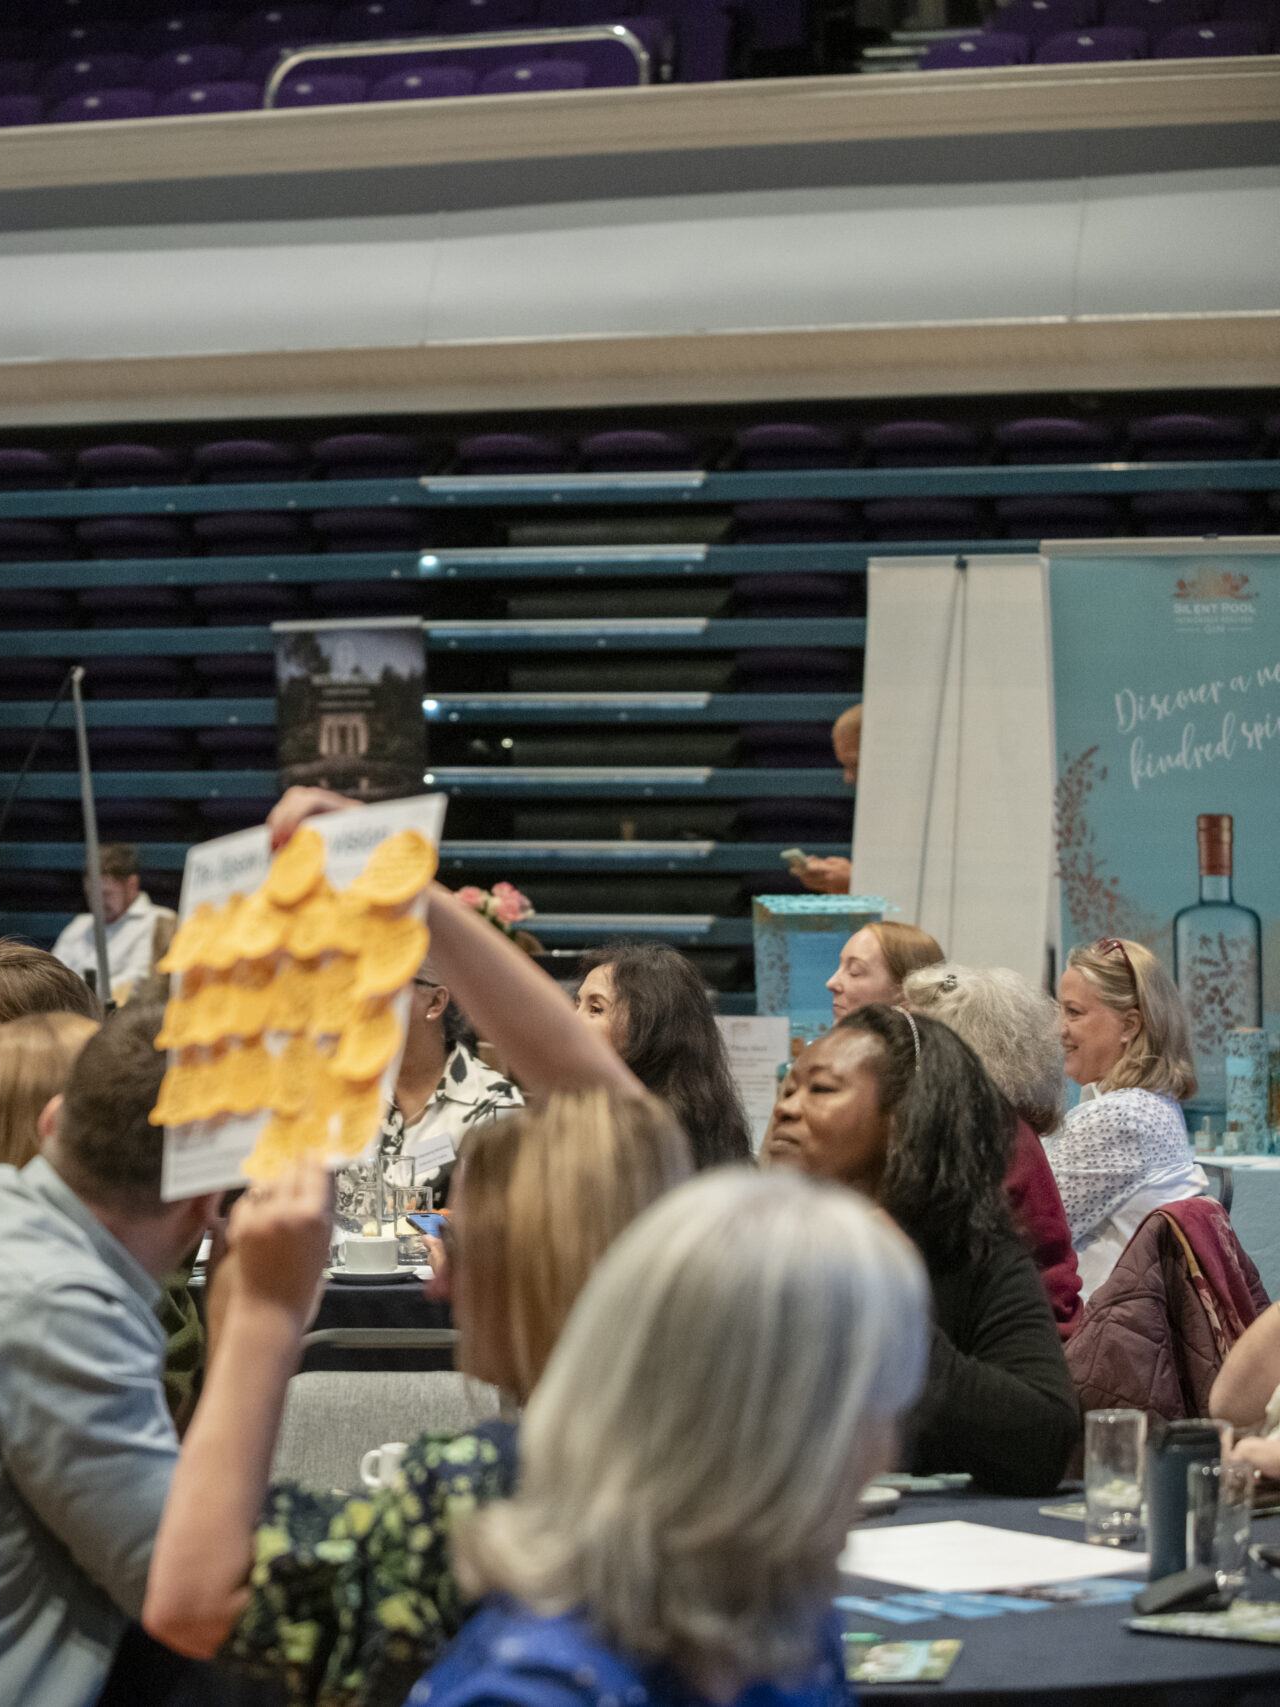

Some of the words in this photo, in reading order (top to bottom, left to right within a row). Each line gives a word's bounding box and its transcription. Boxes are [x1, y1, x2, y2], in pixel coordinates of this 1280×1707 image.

[1221, 602, 1256, 614] POOL
[1114, 681, 1224, 736] Discover
[1230, 675, 1253, 693] a
[1129, 710, 1237, 790] kindred
